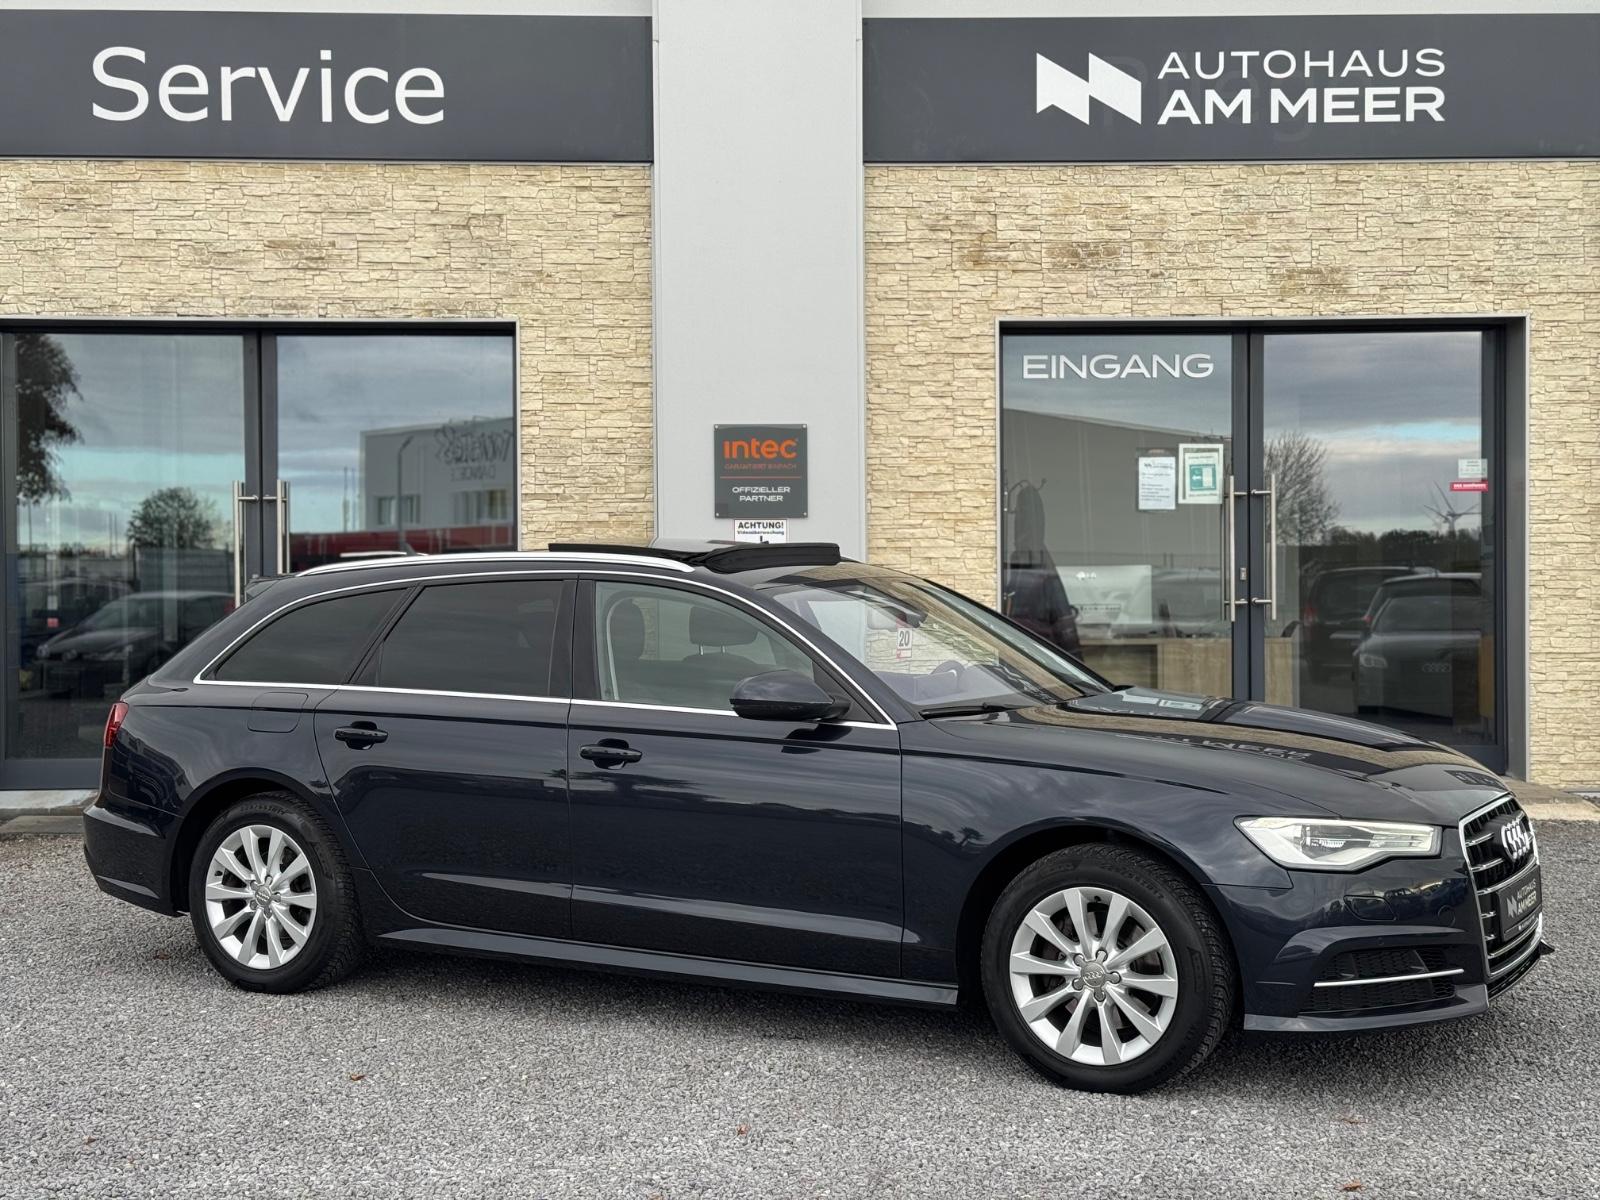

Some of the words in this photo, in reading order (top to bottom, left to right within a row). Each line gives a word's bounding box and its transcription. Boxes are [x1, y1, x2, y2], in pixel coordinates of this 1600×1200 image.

[1157, 48, 1446, 80] AUTOHAUS
[92, 46, 445, 125] Service
[1156, 88, 1252, 125] AM
[1270, 86, 1446, 124] MEER
[1022, 353, 1215, 380] EINGANG
[723, 437, 798, 459] intec
[731, 486, 791, 494] OFFIZIELLER
[738, 521, 784, 529] ACHTUNG!
[898, 630, 911, 647] 20
